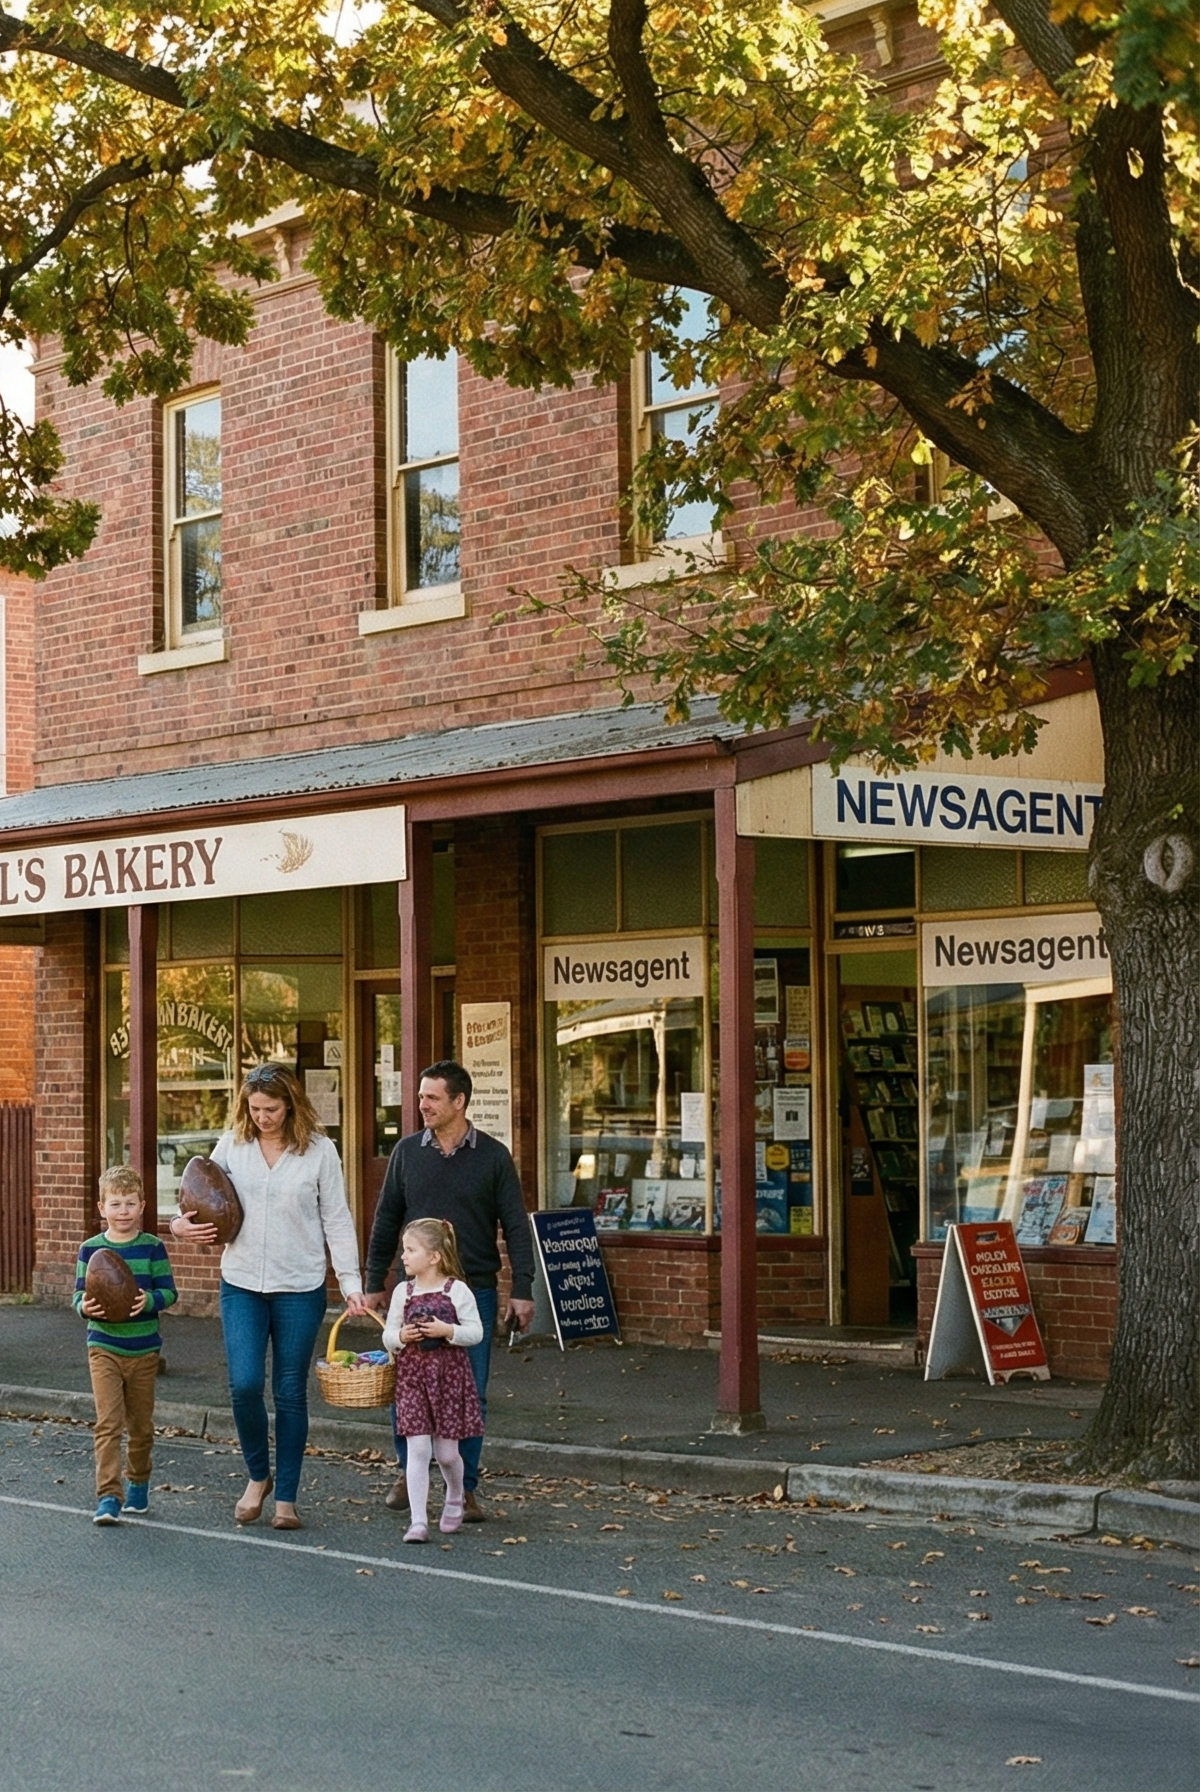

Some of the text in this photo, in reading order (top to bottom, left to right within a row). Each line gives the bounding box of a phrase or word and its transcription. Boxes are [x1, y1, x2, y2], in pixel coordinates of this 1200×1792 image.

[64, 837, 223, 899] BAKERY
[554, 951, 690, 988] Newsagent
[935, 927, 1109, 970] Newsagent
